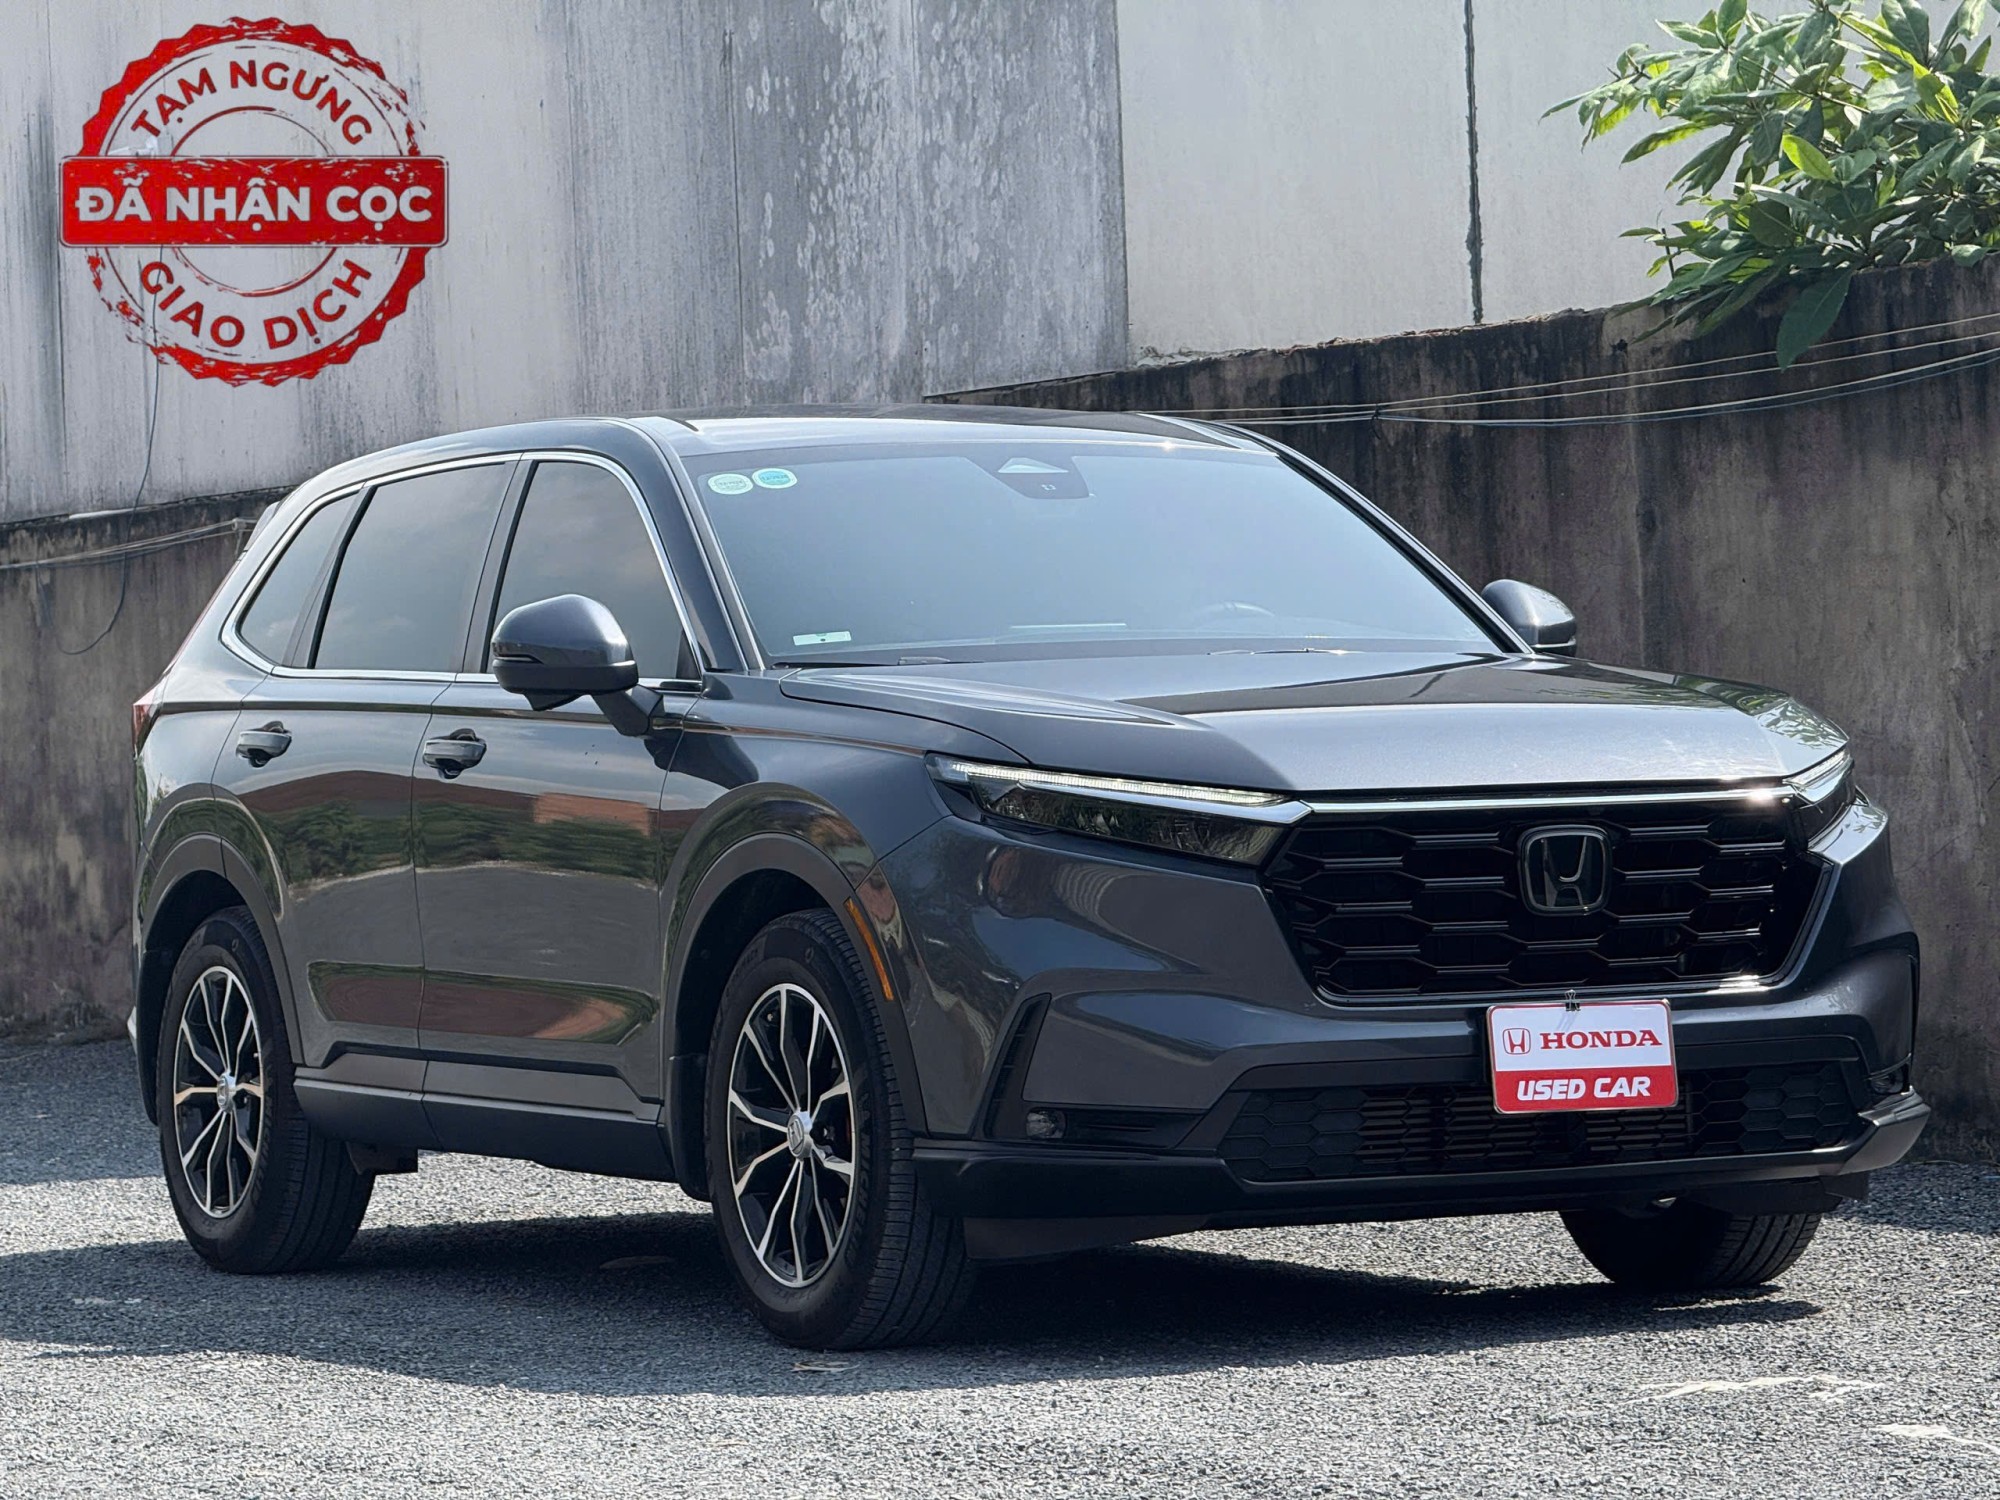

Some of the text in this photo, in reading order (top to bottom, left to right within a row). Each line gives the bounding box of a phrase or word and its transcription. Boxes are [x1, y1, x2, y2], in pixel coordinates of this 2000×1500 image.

[1540, 1029, 1662, 1049] HONDA
[1517, 1076, 1651, 1101] USED CAR
